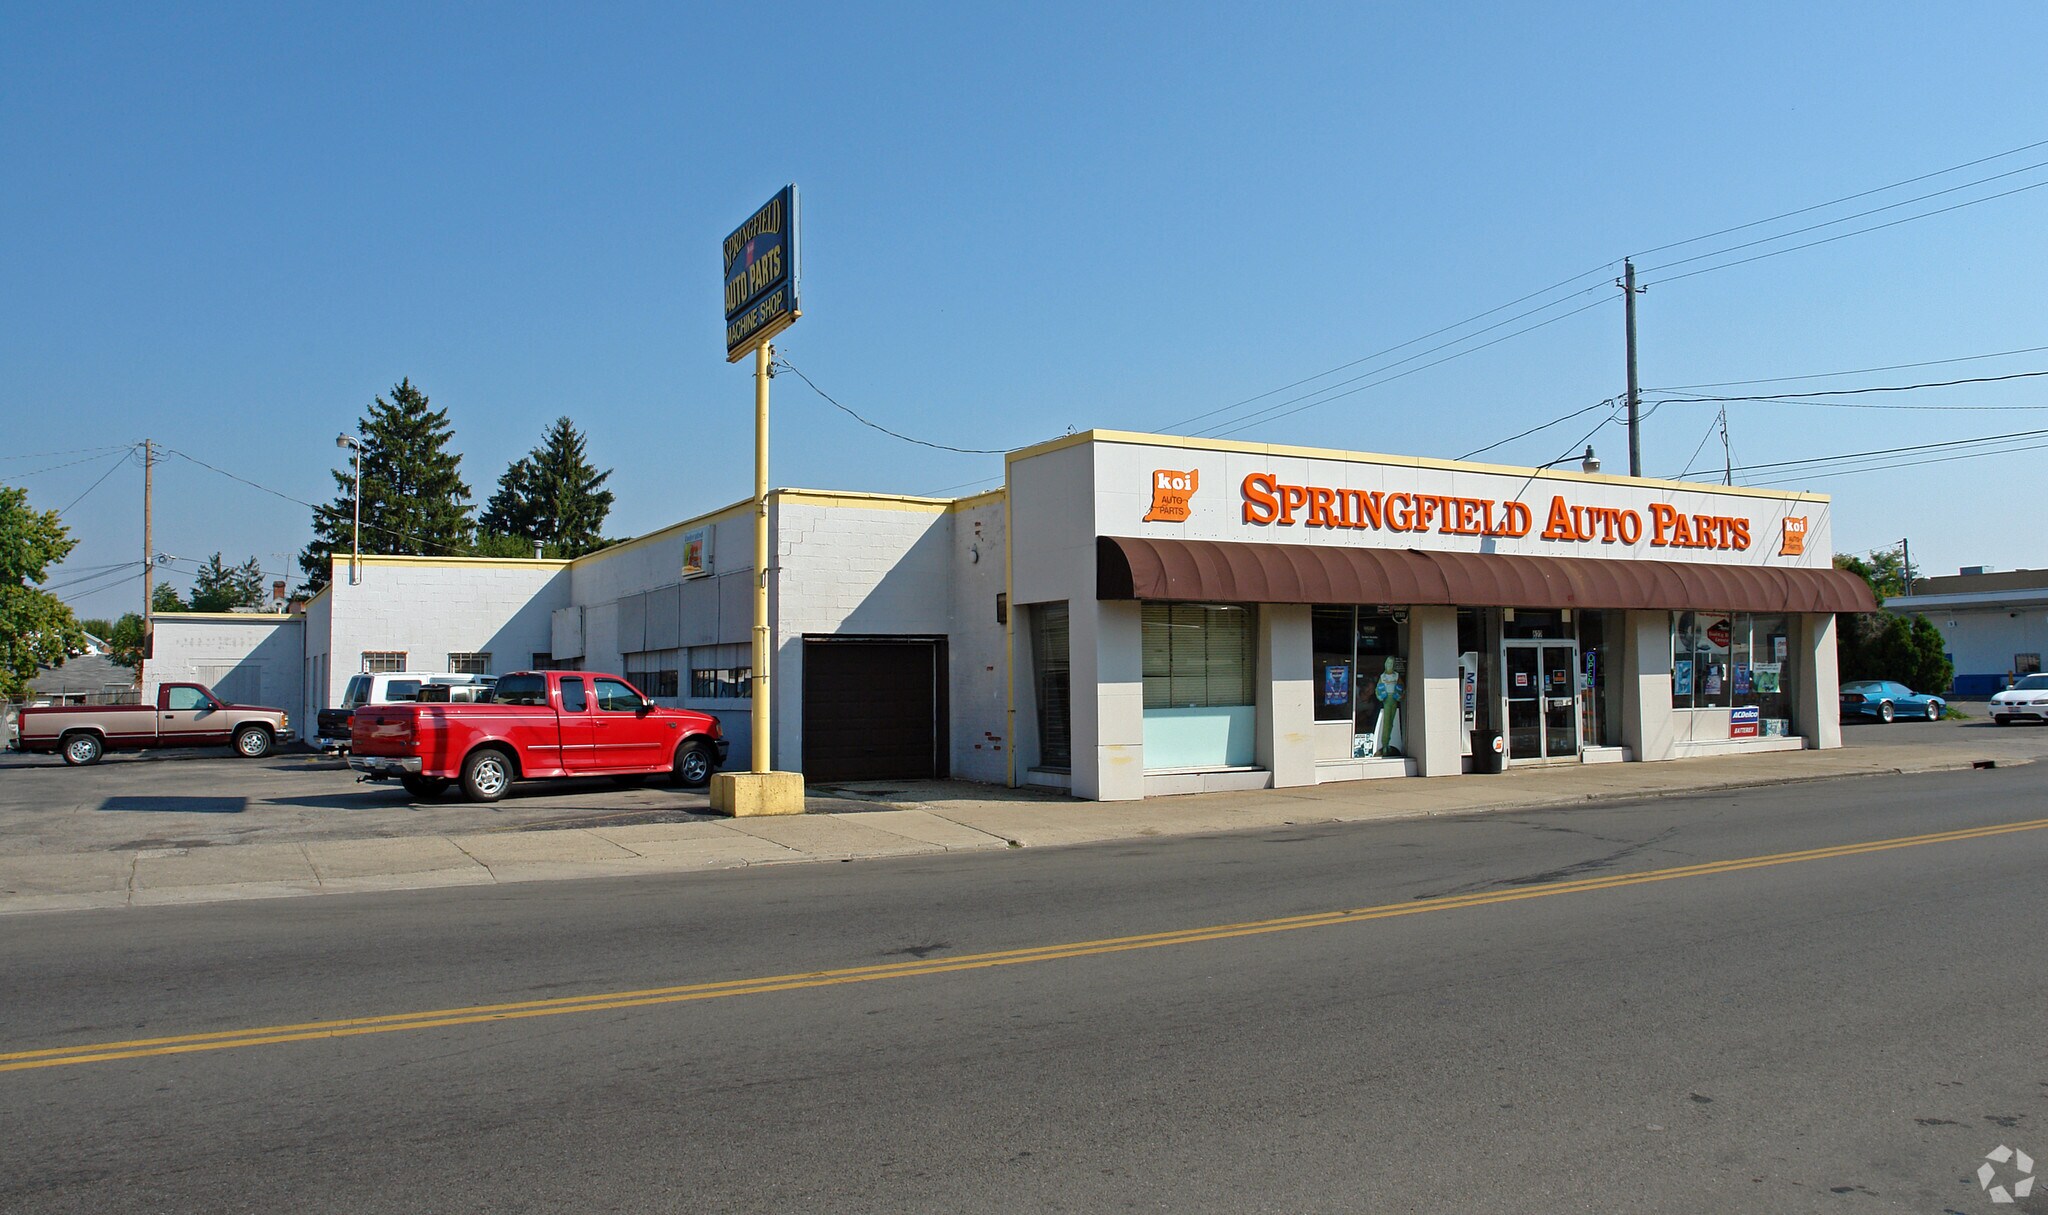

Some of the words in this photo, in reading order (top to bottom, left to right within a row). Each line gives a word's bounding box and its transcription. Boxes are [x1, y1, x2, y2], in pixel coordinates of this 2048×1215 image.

[724, 198, 781, 278] SPRINGFIELD
[726, 271, 748, 314] AUTO
[749, 244, 781, 295] PARTS
[728, 307, 758, 346] MACHINE
[759, 290, 783, 322] SHOP
[1157, 472, 1191, 491] koi
[1159, 505, 1185, 516] PARTS
[1161, 495, 1183, 505] AUTO
[1242, 472, 1533, 538] SPRINGFIELD
[1541, 495, 1643, 545] AUTO
[1648, 503, 1752, 551] PARTS
[1785, 519, 1805, 533] koi
[1587, 653, 1595, 686] OPEN
[1464, 672, 1475, 709] Mobil
[1732, 710, 1758, 719] ACDelco
